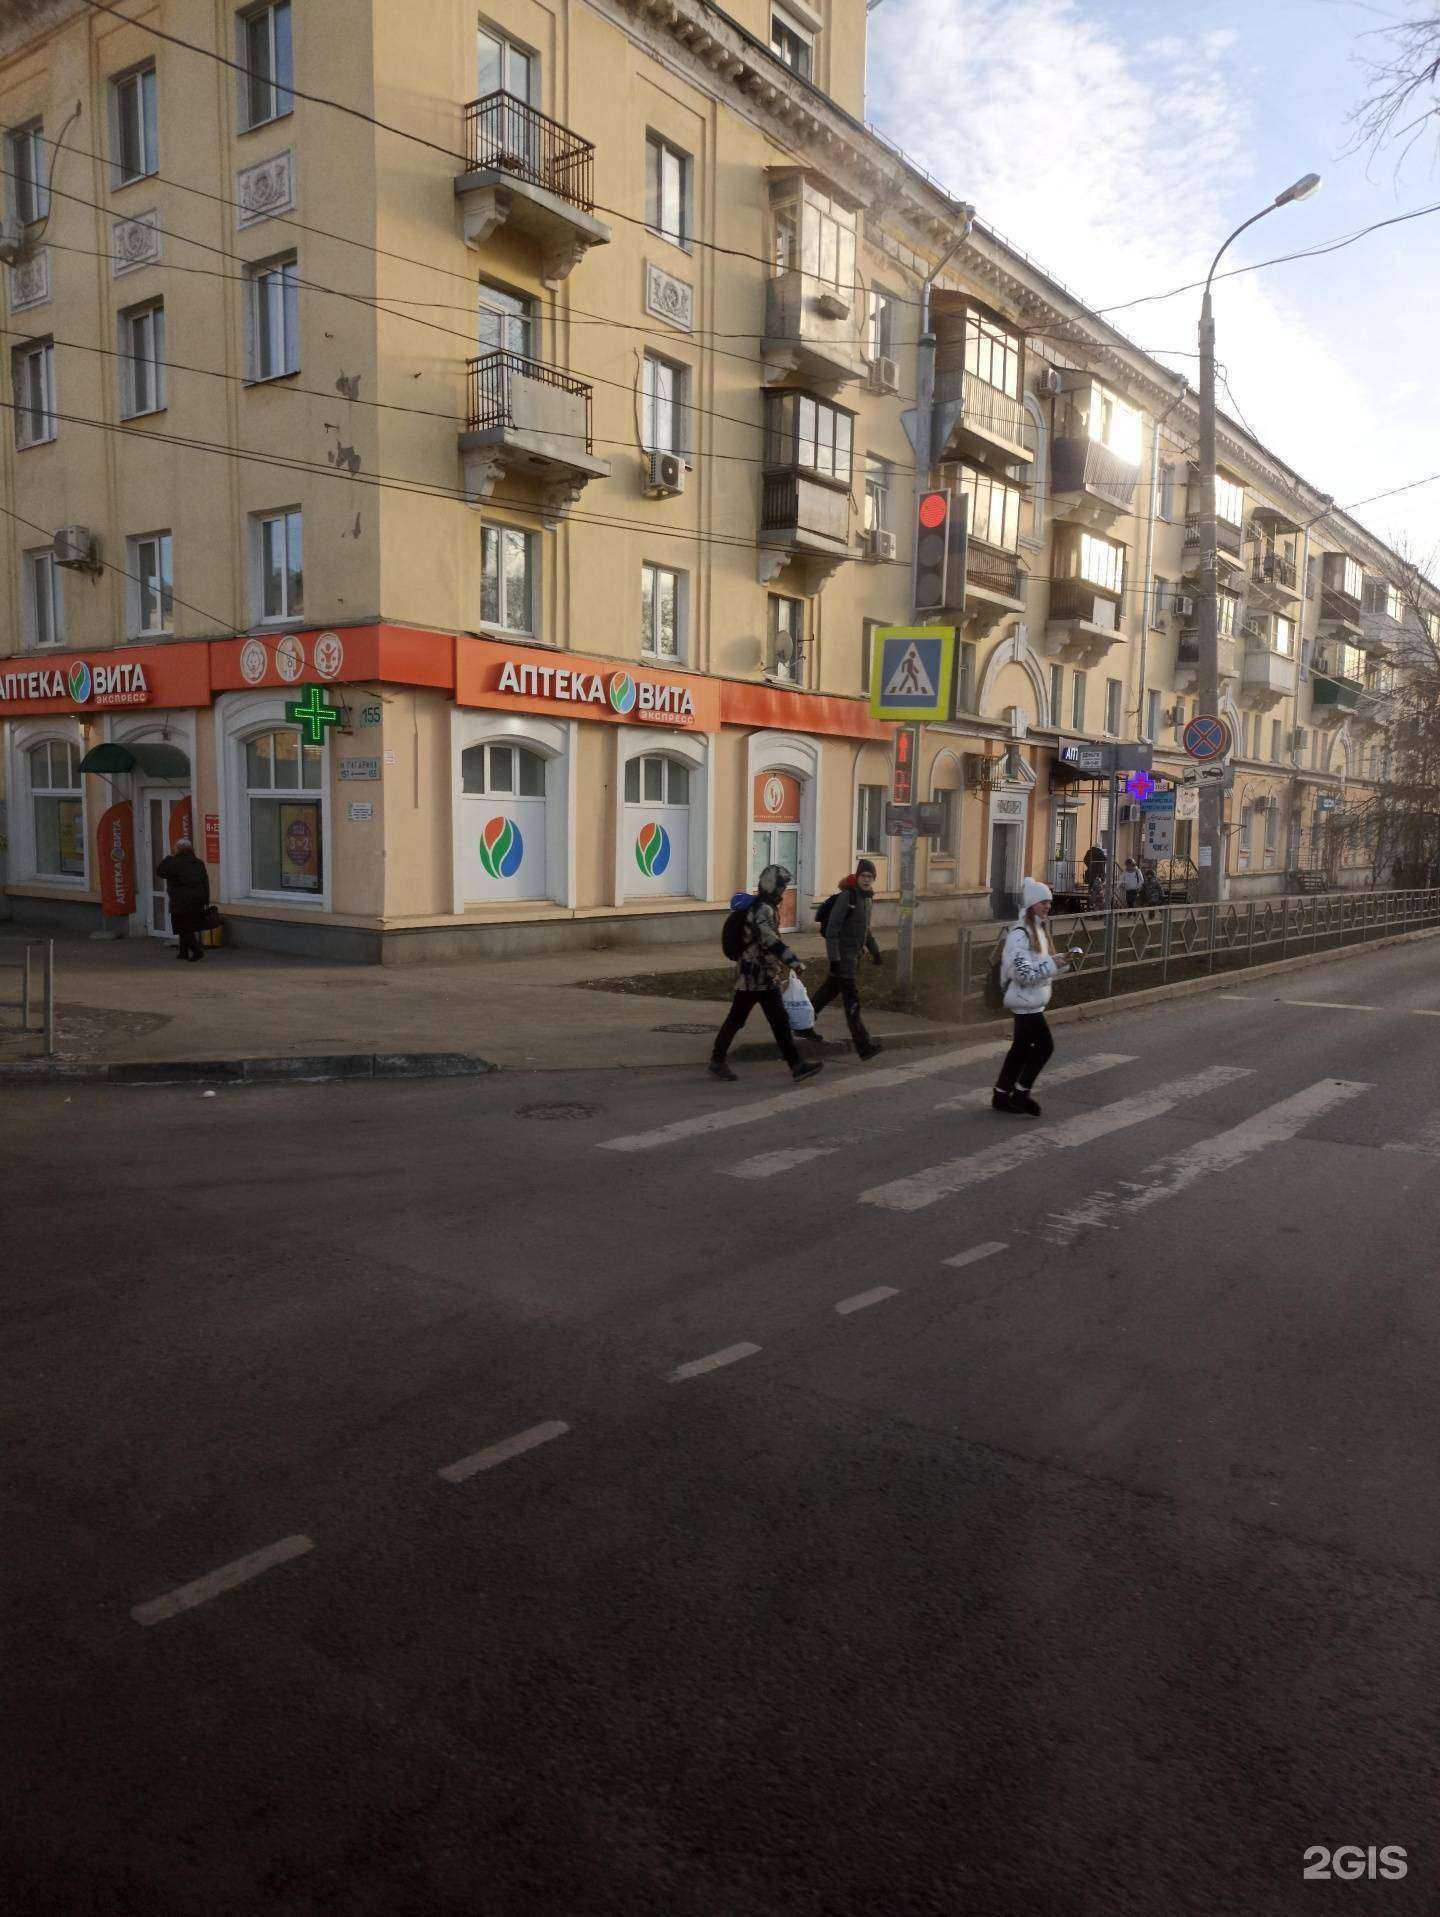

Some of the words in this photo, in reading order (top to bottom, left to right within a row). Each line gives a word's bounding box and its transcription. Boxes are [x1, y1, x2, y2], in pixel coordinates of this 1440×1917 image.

[93, 663, 148, 695] ВИТА
[498, 661, 607, 704] АПТЕКА
[639, 682, 696, 714] ВИТА
[96, 693, 147, 704] ЭКСПРЕСС
[361, 706, 381, 723] 155
[640, 710, 694, 725] ЭКСПРЕСС
